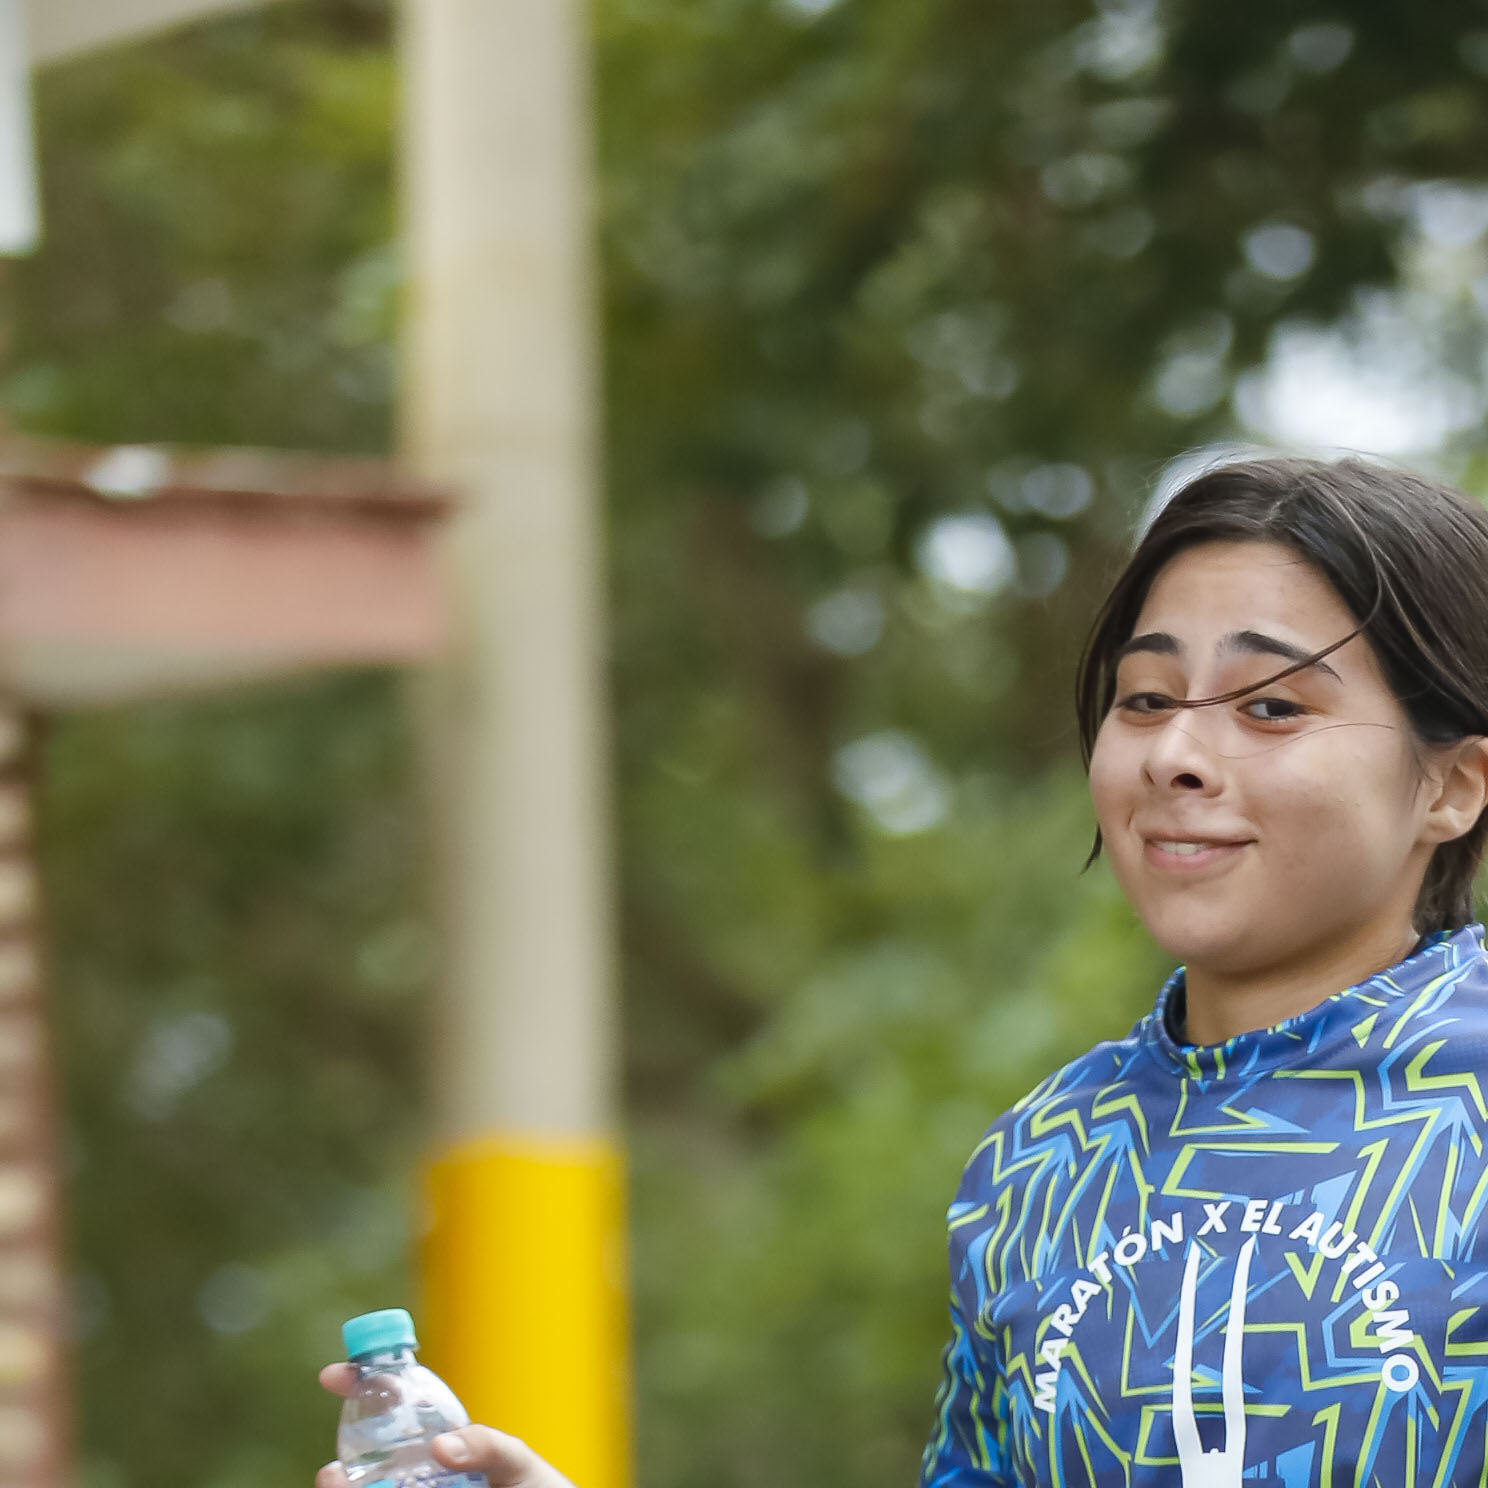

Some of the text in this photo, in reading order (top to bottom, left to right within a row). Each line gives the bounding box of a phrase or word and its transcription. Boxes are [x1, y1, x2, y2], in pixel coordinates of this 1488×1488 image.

[1034, 1199, 1420, 1414] MARATÓN X EL AUTISMO
